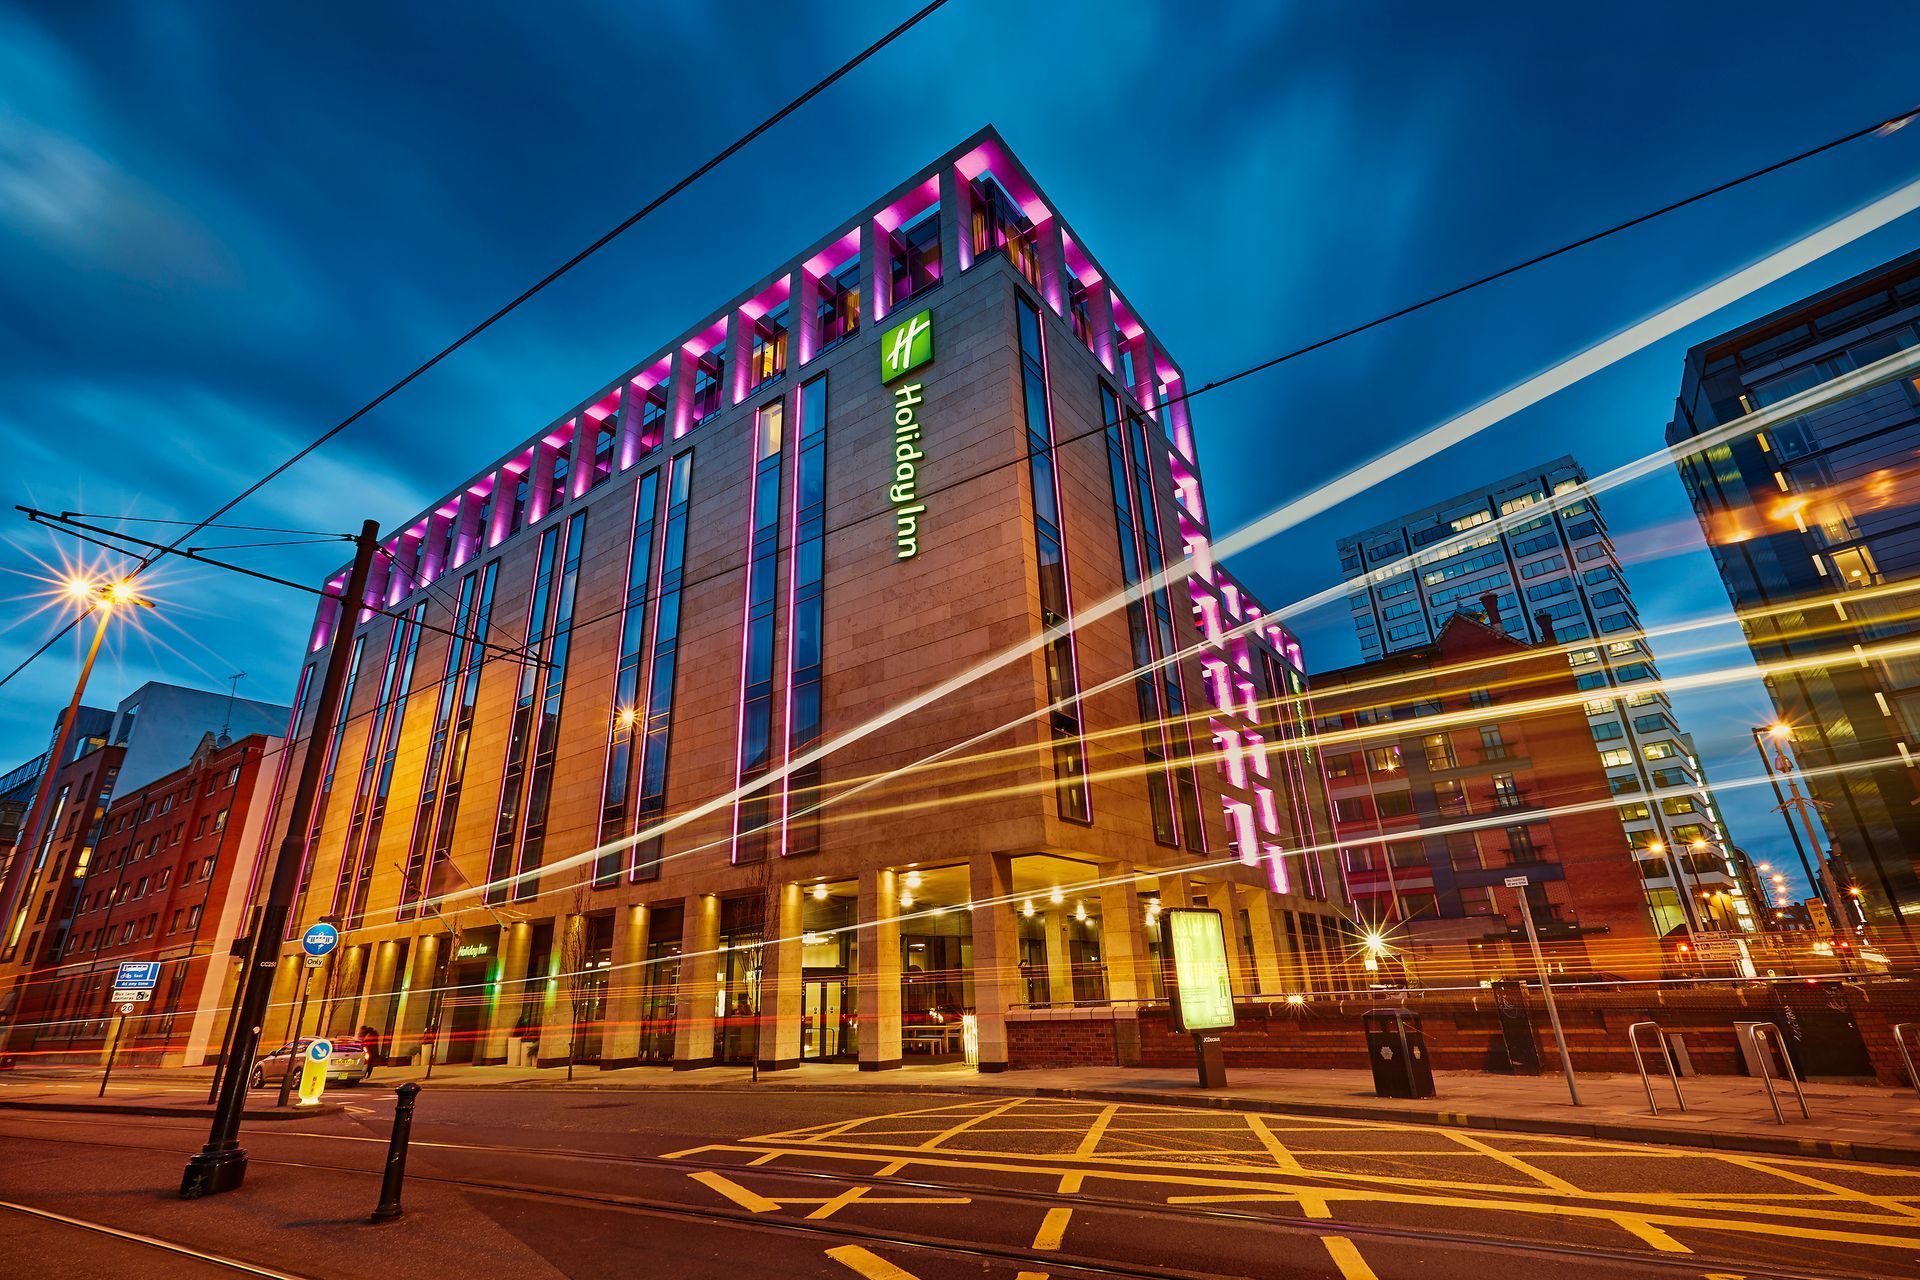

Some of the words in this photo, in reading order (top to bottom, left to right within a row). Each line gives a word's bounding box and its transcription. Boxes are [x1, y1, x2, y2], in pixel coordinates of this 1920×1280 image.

[889, 383, 923, 503] Holiday
[897, 504, 926, 559] Inn
[458, 945, 478, 958] Holiday
[478, 944, 488, 954] Inn
